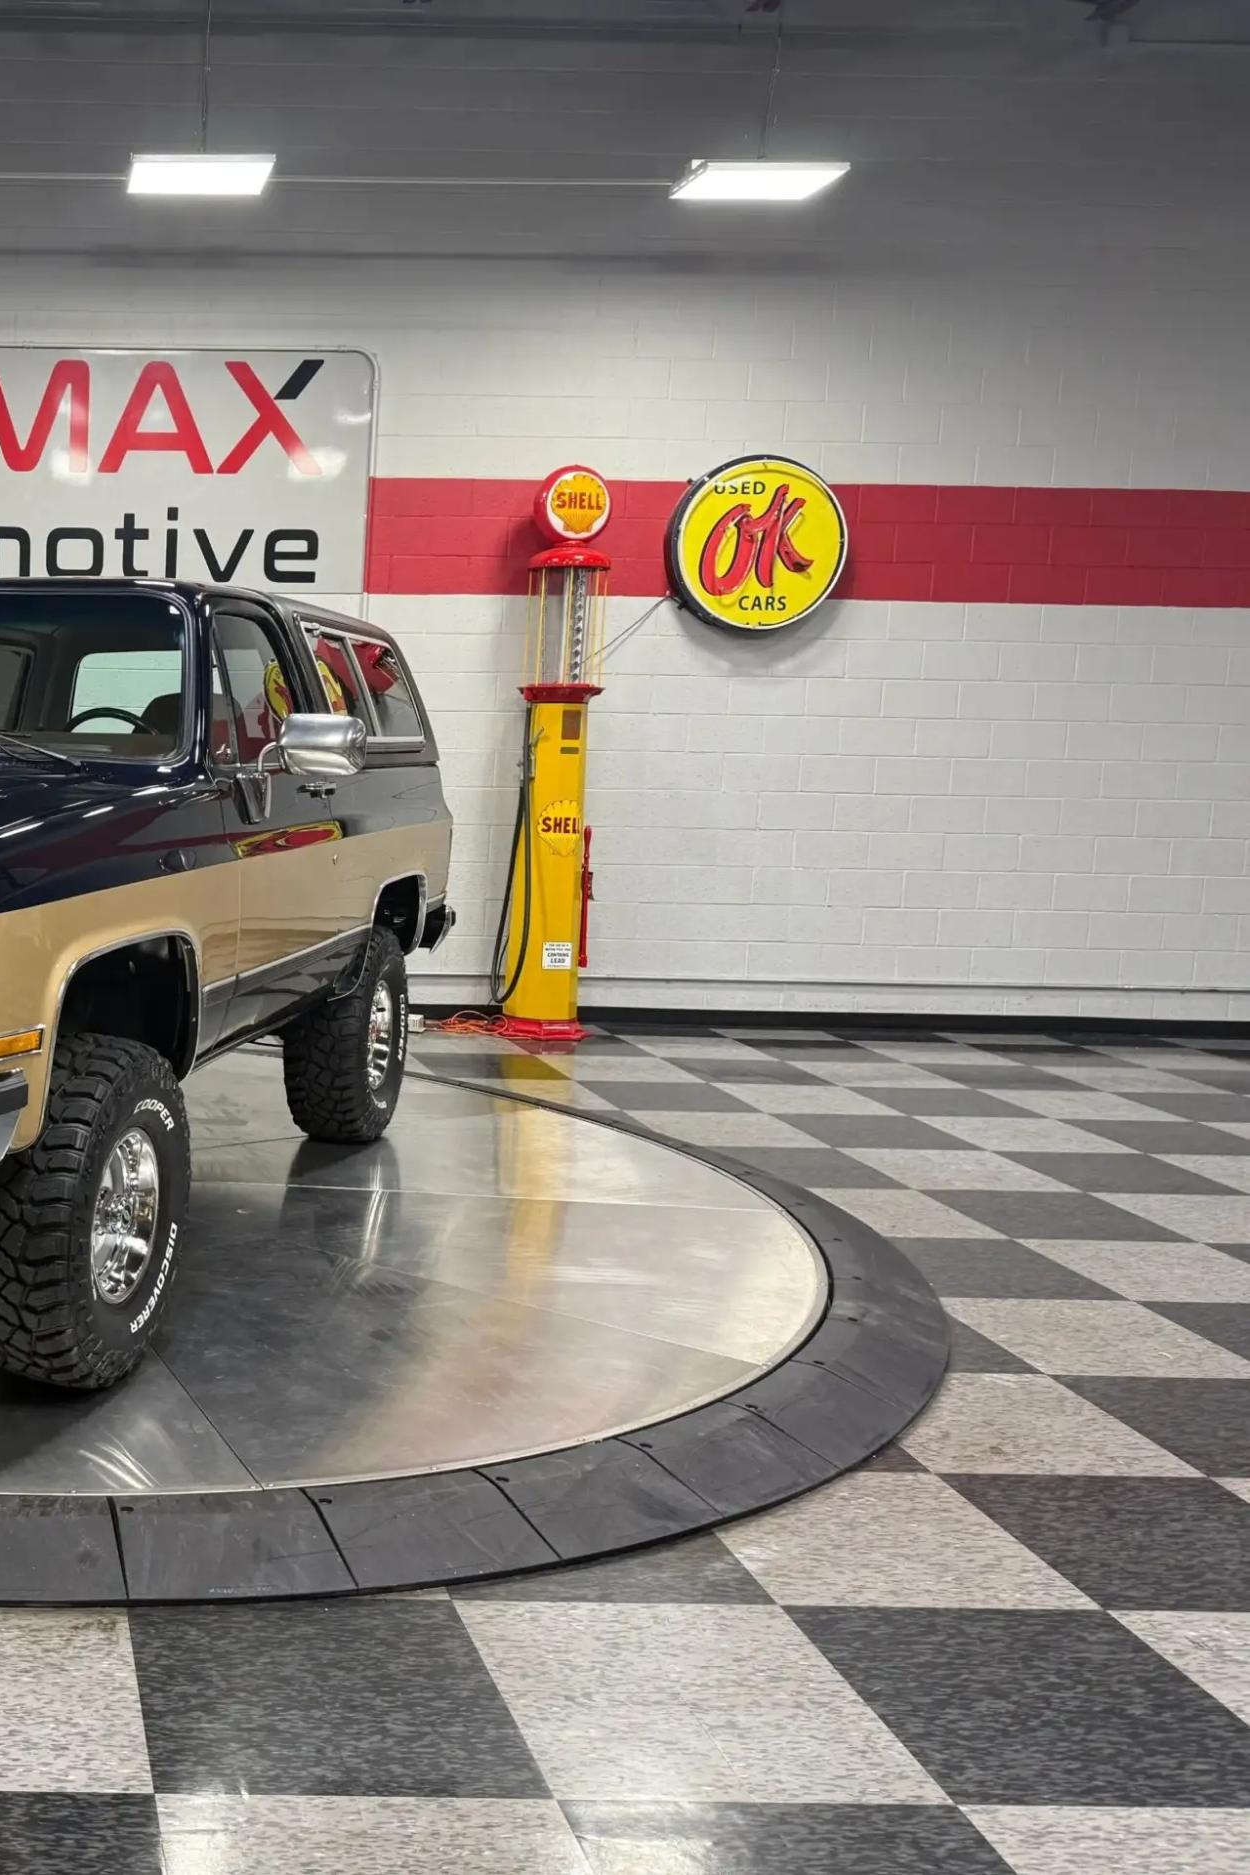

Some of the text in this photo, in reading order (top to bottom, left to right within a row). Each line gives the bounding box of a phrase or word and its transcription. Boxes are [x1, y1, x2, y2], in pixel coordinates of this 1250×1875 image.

[555, 491, 603, 511] SHELL
[713, 480, 766, 495] USED
[699, 483, 814, 596] OK
[738, 595, 787, 611] CARS
[134, 1098, 176, 1132] COOPER
[129, 1221, 179, 1334] DISCOVERER
